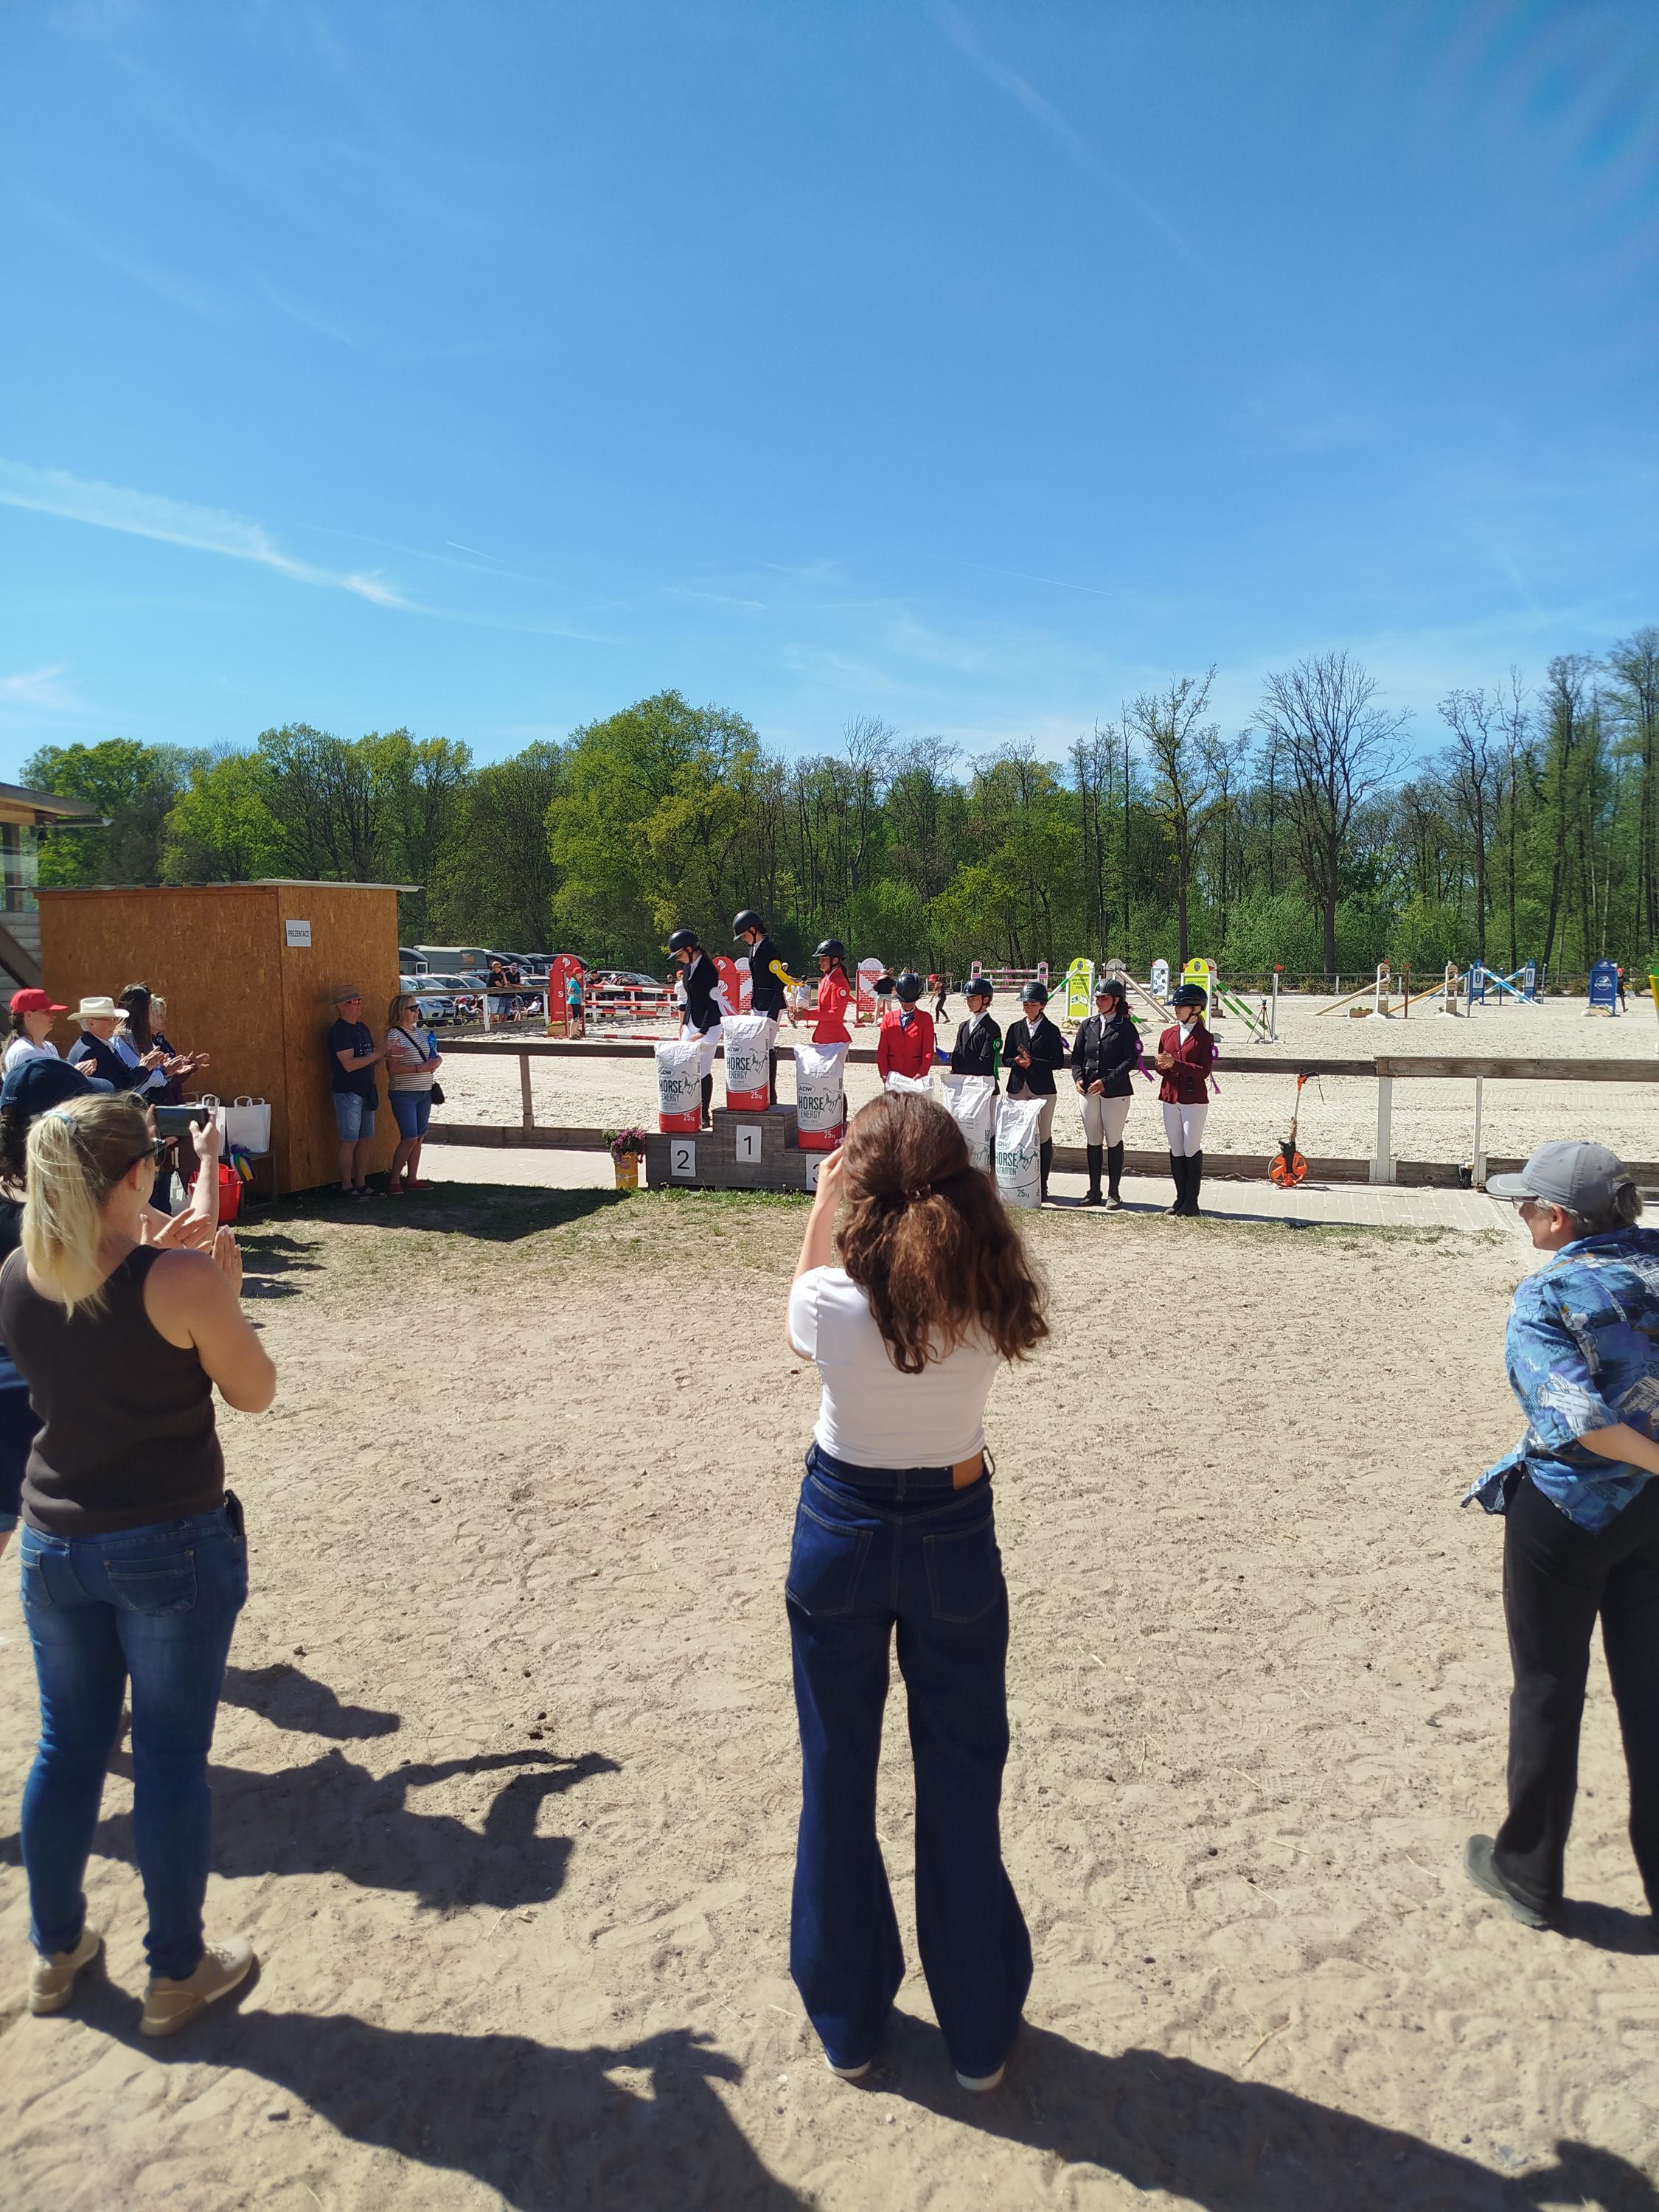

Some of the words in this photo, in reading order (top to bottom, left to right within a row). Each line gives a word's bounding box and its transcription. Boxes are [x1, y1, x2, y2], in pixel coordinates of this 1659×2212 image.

[288, 929, 310, 937] PREZENTACE
[726, 1057, 751, 1071] HORSE
[728, 1069, 748, 1079] ENERGY
[659, 1079, 684, 1093] HORSE
[661, 1092, 680, 1102] ENERGY
[799, 1095, 824, 1110] HORSE
[801, 1109, 821, 1119] ENERGY
[743, 1135, 752, 1155] 1
[677, 1150, 690, 1169] 2
